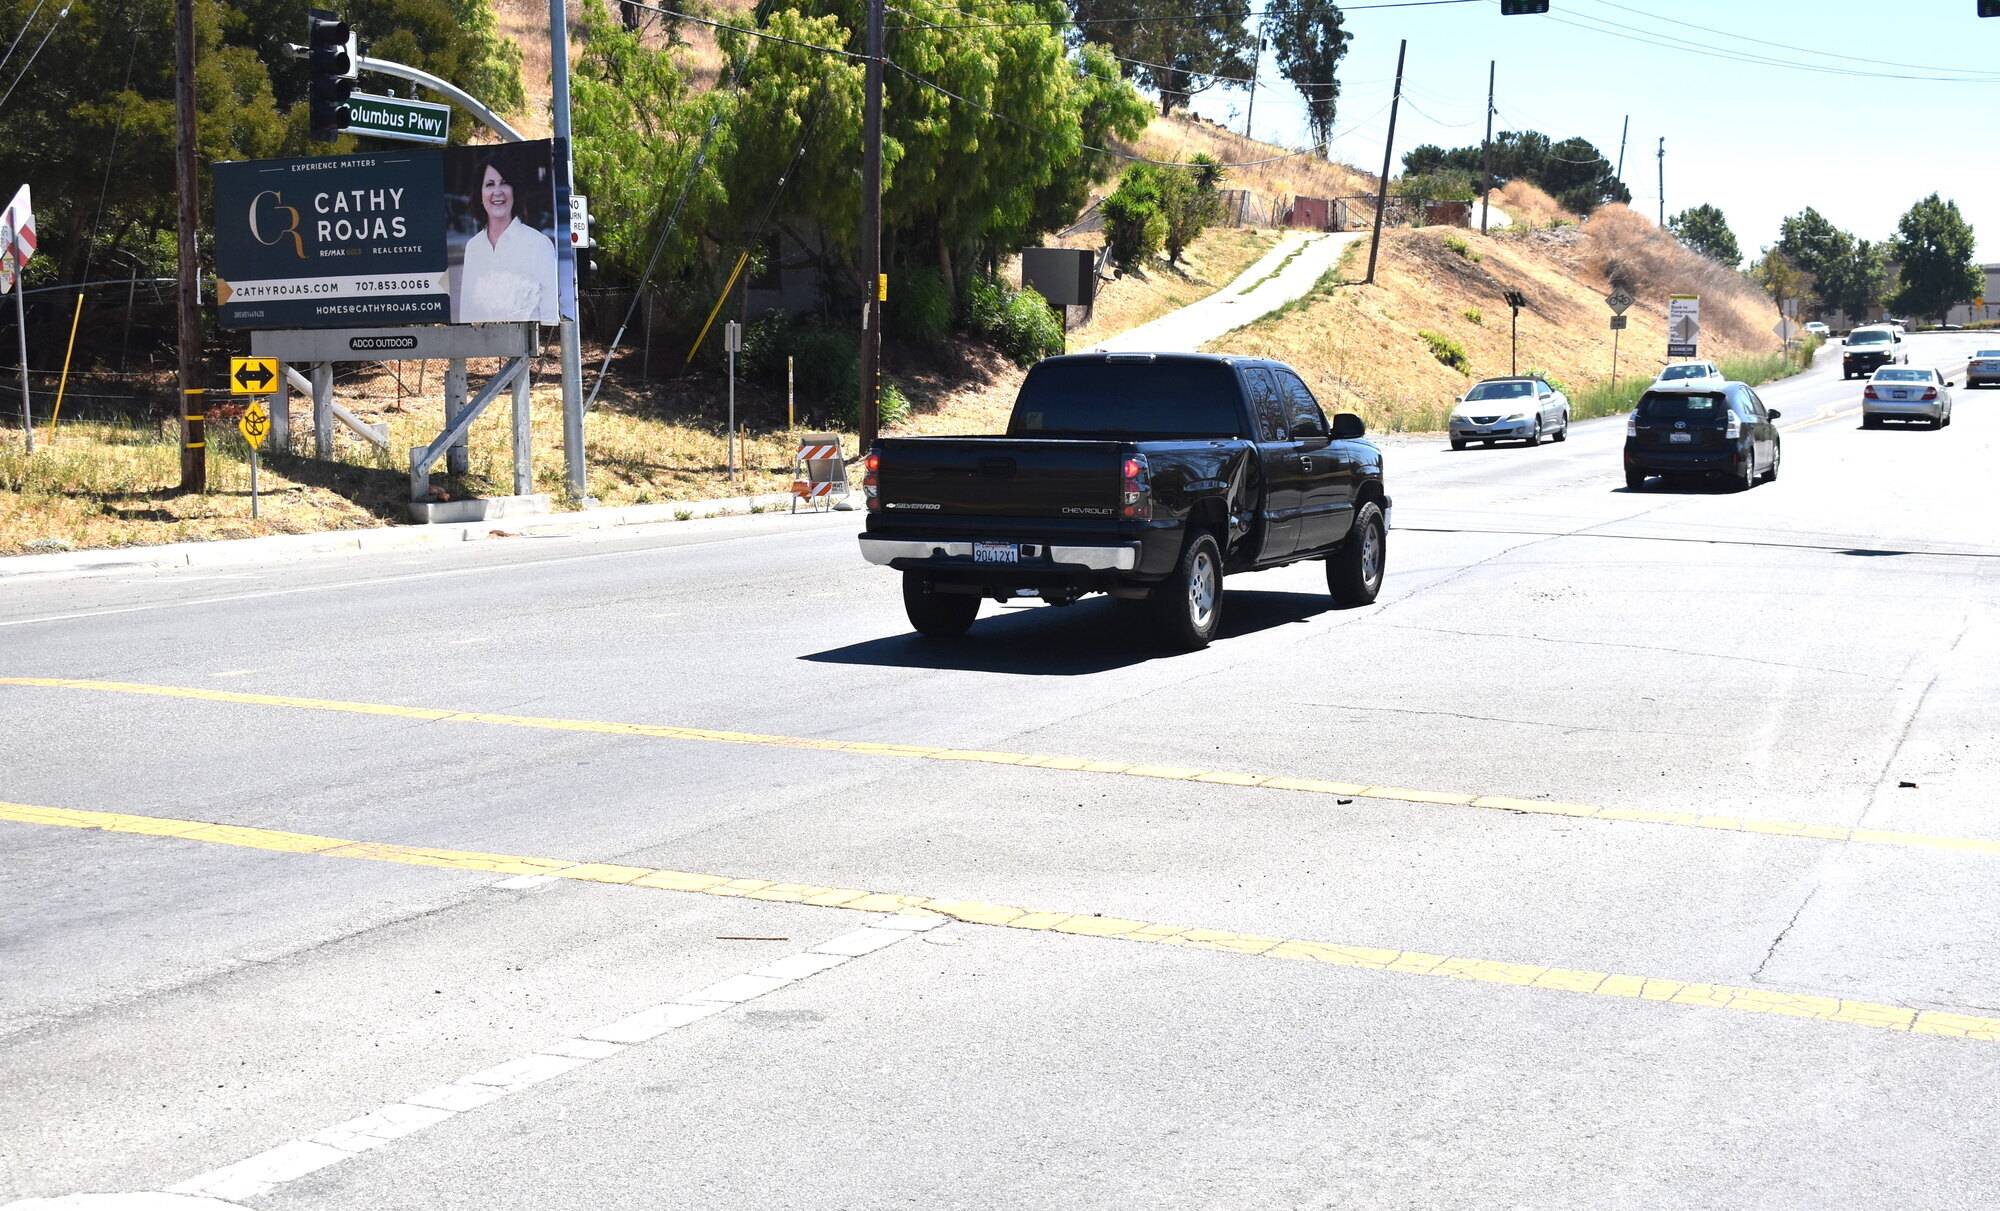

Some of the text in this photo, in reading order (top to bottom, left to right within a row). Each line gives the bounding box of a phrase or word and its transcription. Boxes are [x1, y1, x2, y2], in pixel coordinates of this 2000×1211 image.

[343, 103, 442, 135] olumbus Pkwy
[291, 159, 376, 172] EXPERIENCE MATTERS
[314, 188, 404, 214] CATHY
[570, 212, 582, 220] URN
[317, 216, 407, 242] ROJAS
[574, 222, 586, 231] RED
[319, 249, 345, 257] RE/MAX
[236, 279, 430, 297] CATHYROJAS.COM 707.853.0066
[316, 302, 442, 315] HOMES@CATHYROJAS.COM
[352, 338, 413, 348] ADCO OUTDOOR
[1062, 506, 1114, 515] CHEVROLET
[976, 549, 1015, 564] 90412X1
